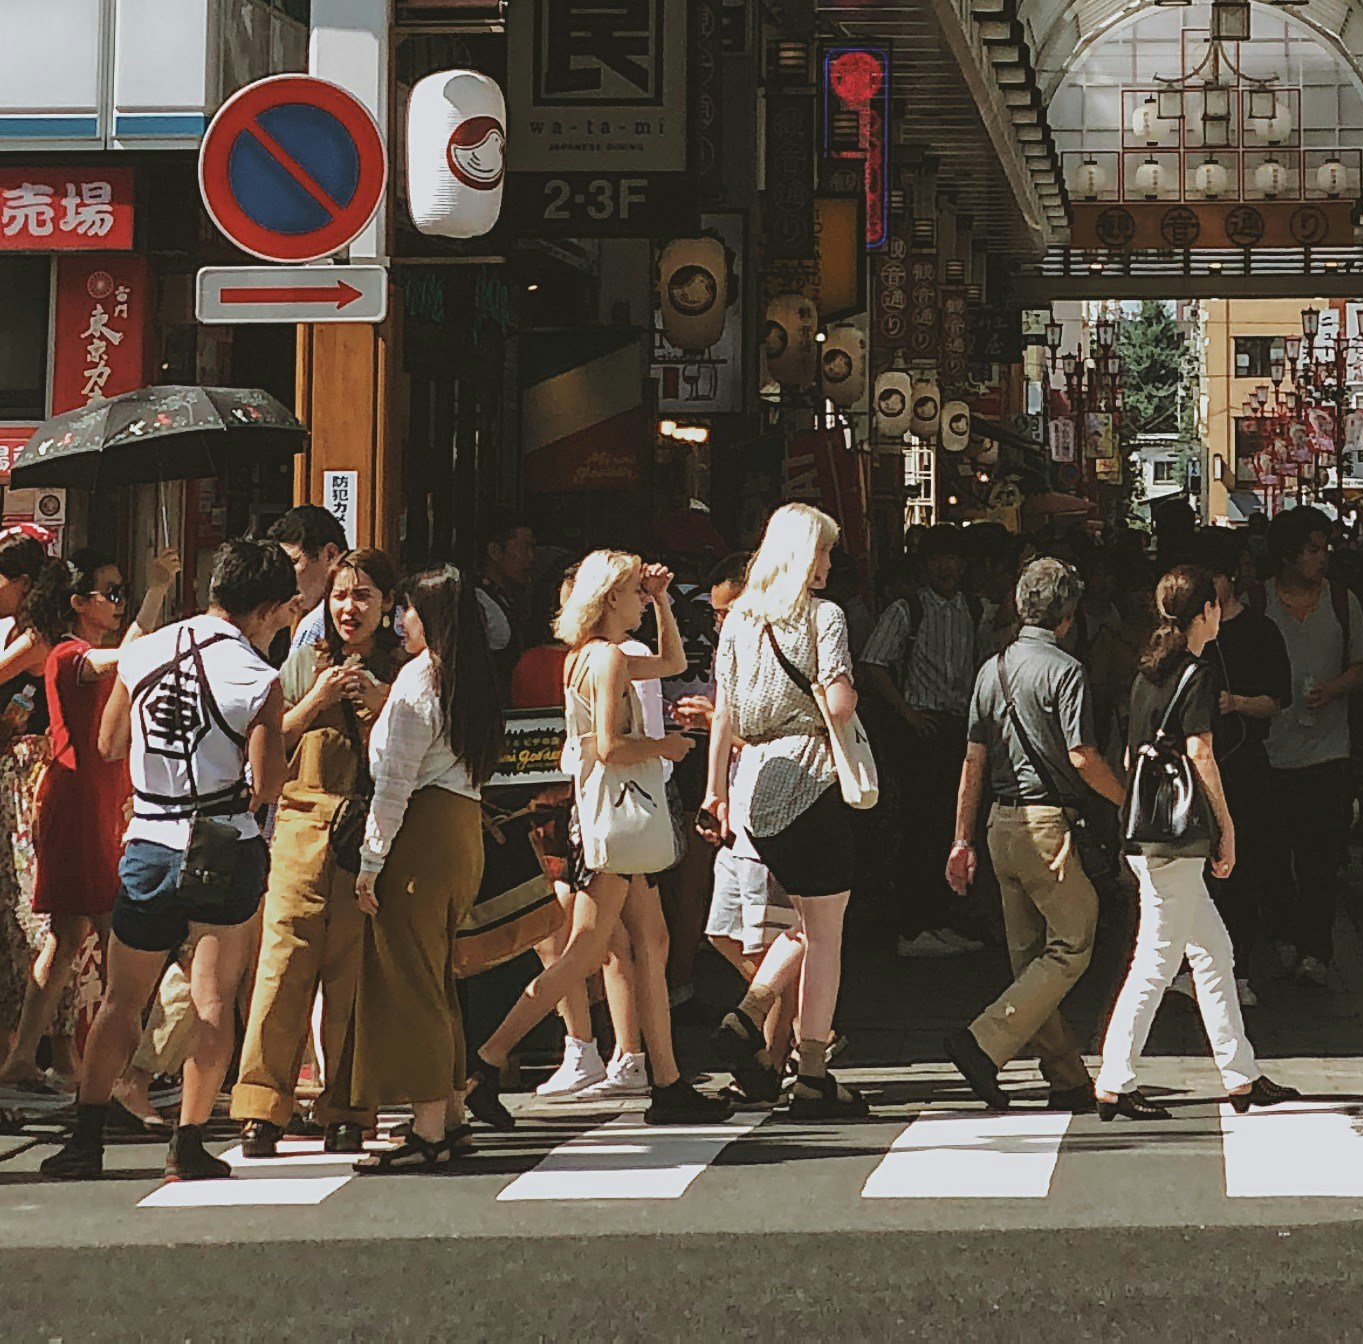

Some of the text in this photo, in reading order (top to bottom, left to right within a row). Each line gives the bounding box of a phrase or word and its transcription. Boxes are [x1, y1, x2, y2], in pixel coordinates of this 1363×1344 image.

[1, 181, 115, 238] 売場
[1096, 206, 1330, 246] 観音通り
